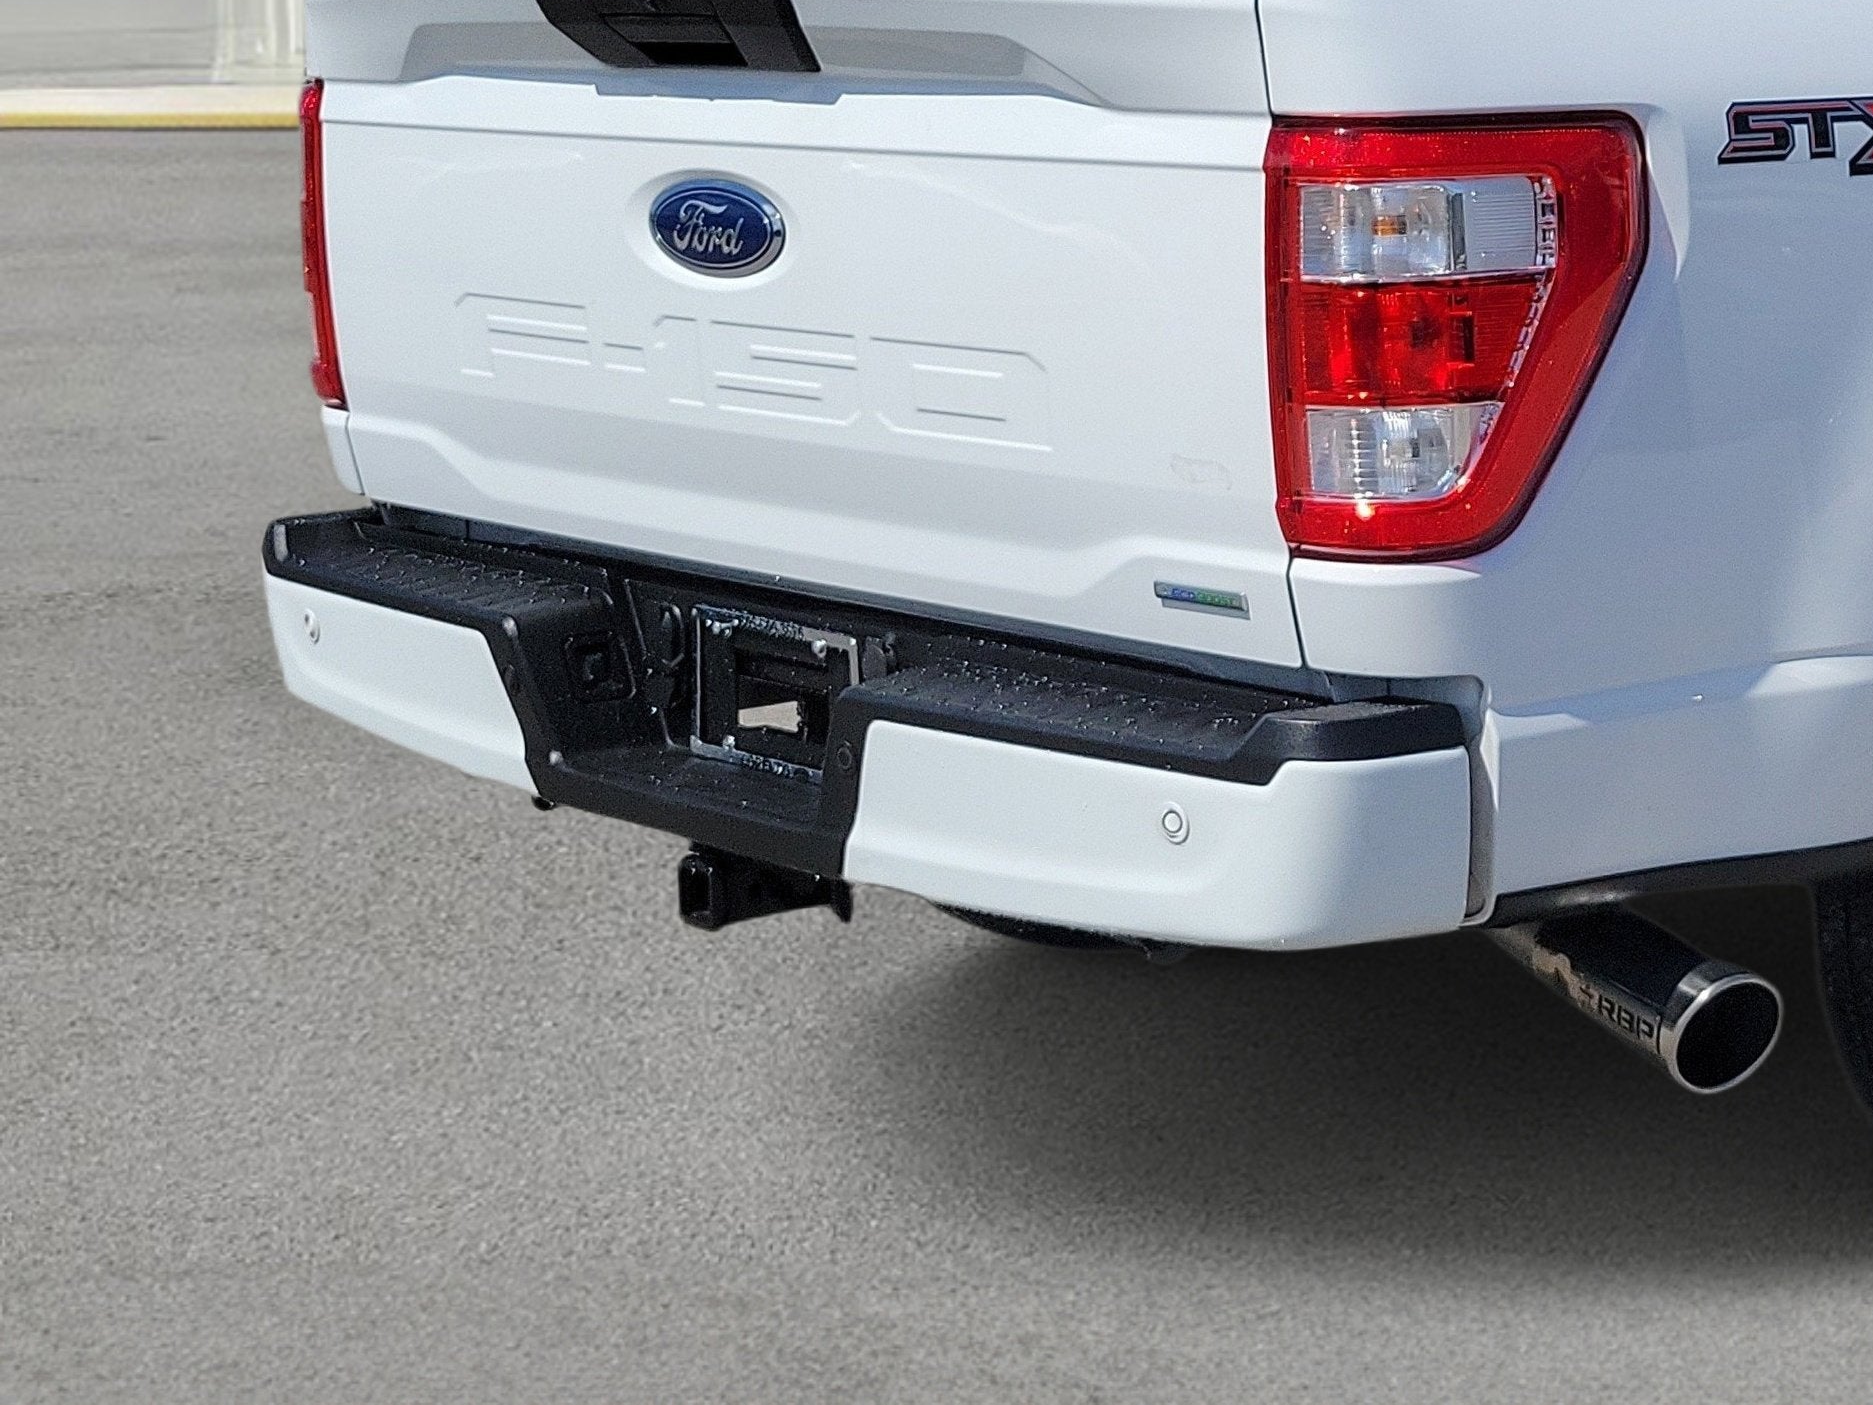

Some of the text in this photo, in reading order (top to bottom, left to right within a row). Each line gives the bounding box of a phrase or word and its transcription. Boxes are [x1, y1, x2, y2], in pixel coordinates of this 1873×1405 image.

[673, 199, 745, 256] Ford
[455, 292, 1053, 451] F-150
[1598, 994, 1654, 1040] RBP
